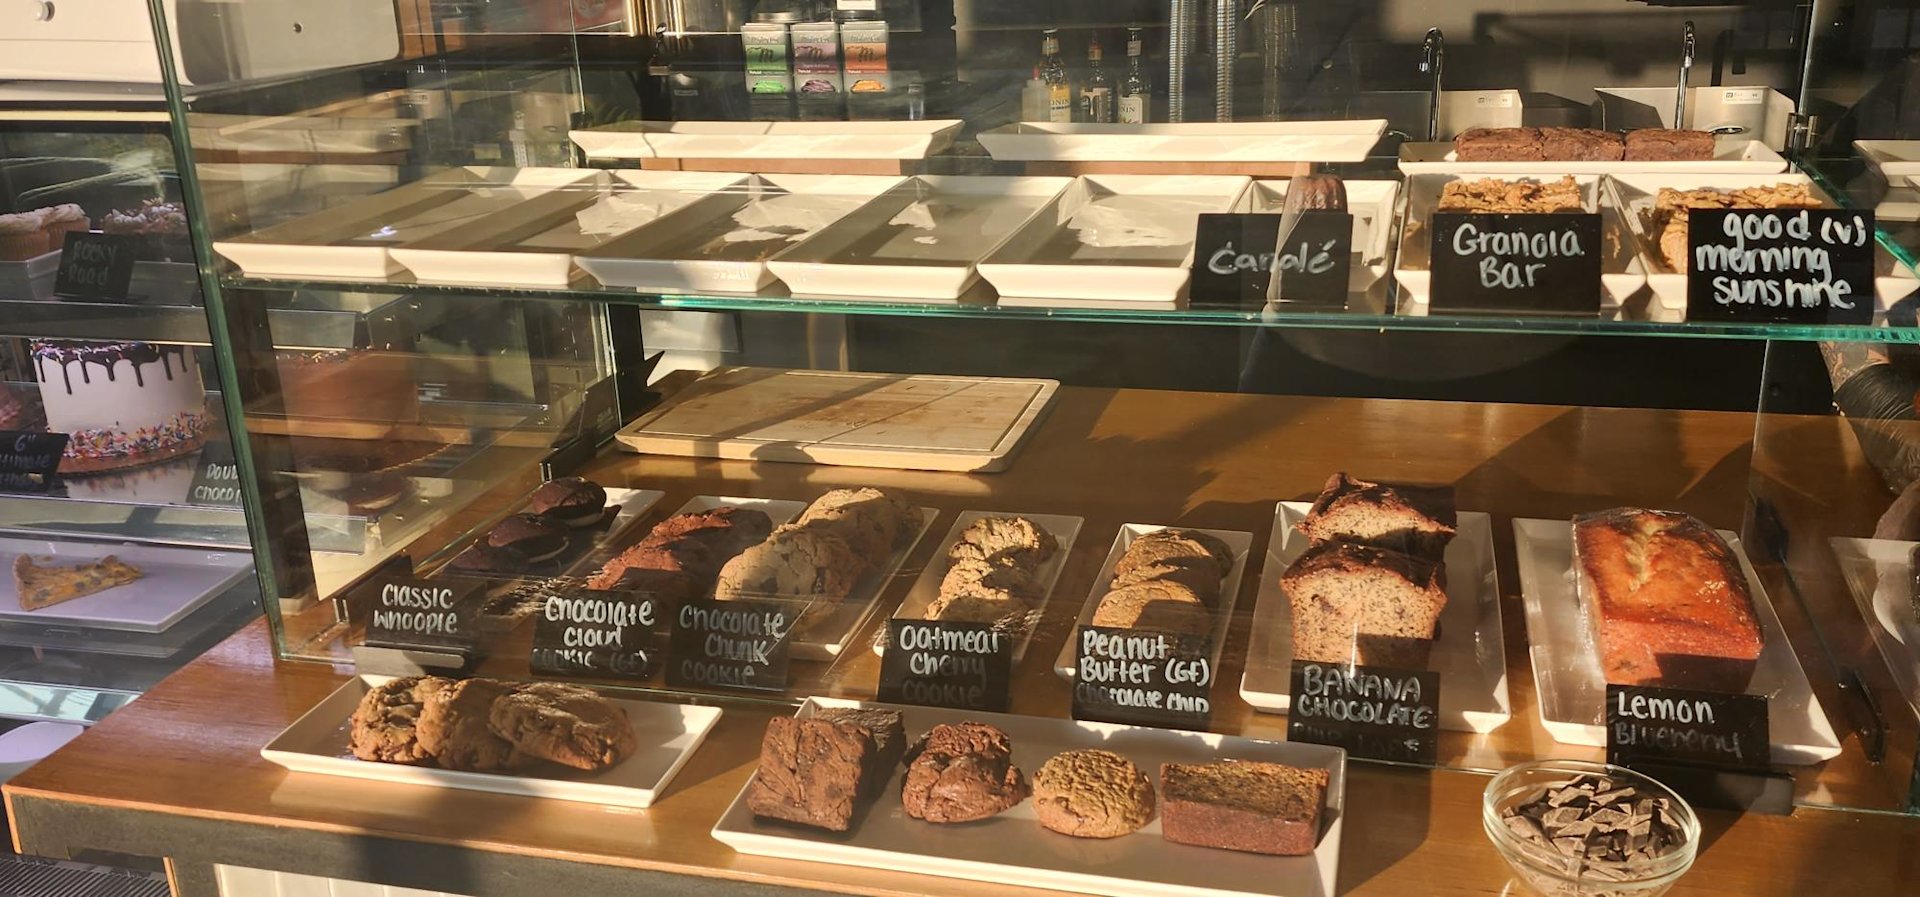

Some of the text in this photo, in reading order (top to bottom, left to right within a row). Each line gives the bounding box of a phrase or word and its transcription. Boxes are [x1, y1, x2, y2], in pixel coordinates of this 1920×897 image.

[1452, 222, 1586, 258] Granola
[1723, 210, 1812, 250] good
[1479, 256, 1546, 289] Bar
[1696, 244, 1832, 285] morning
[545, 596, 655, 626] Chocolate
[900, 625, 998, 653] Oatmeal
[1083, 629, 1169, 660] Peanut
[1080, 656, 1156, 684] Butter
[1303, 664, 1421, 702] BANANA
[1298, 694, 1433, 728] CHOCOLATE
[1618, 691, 1715, 724] Lemon
